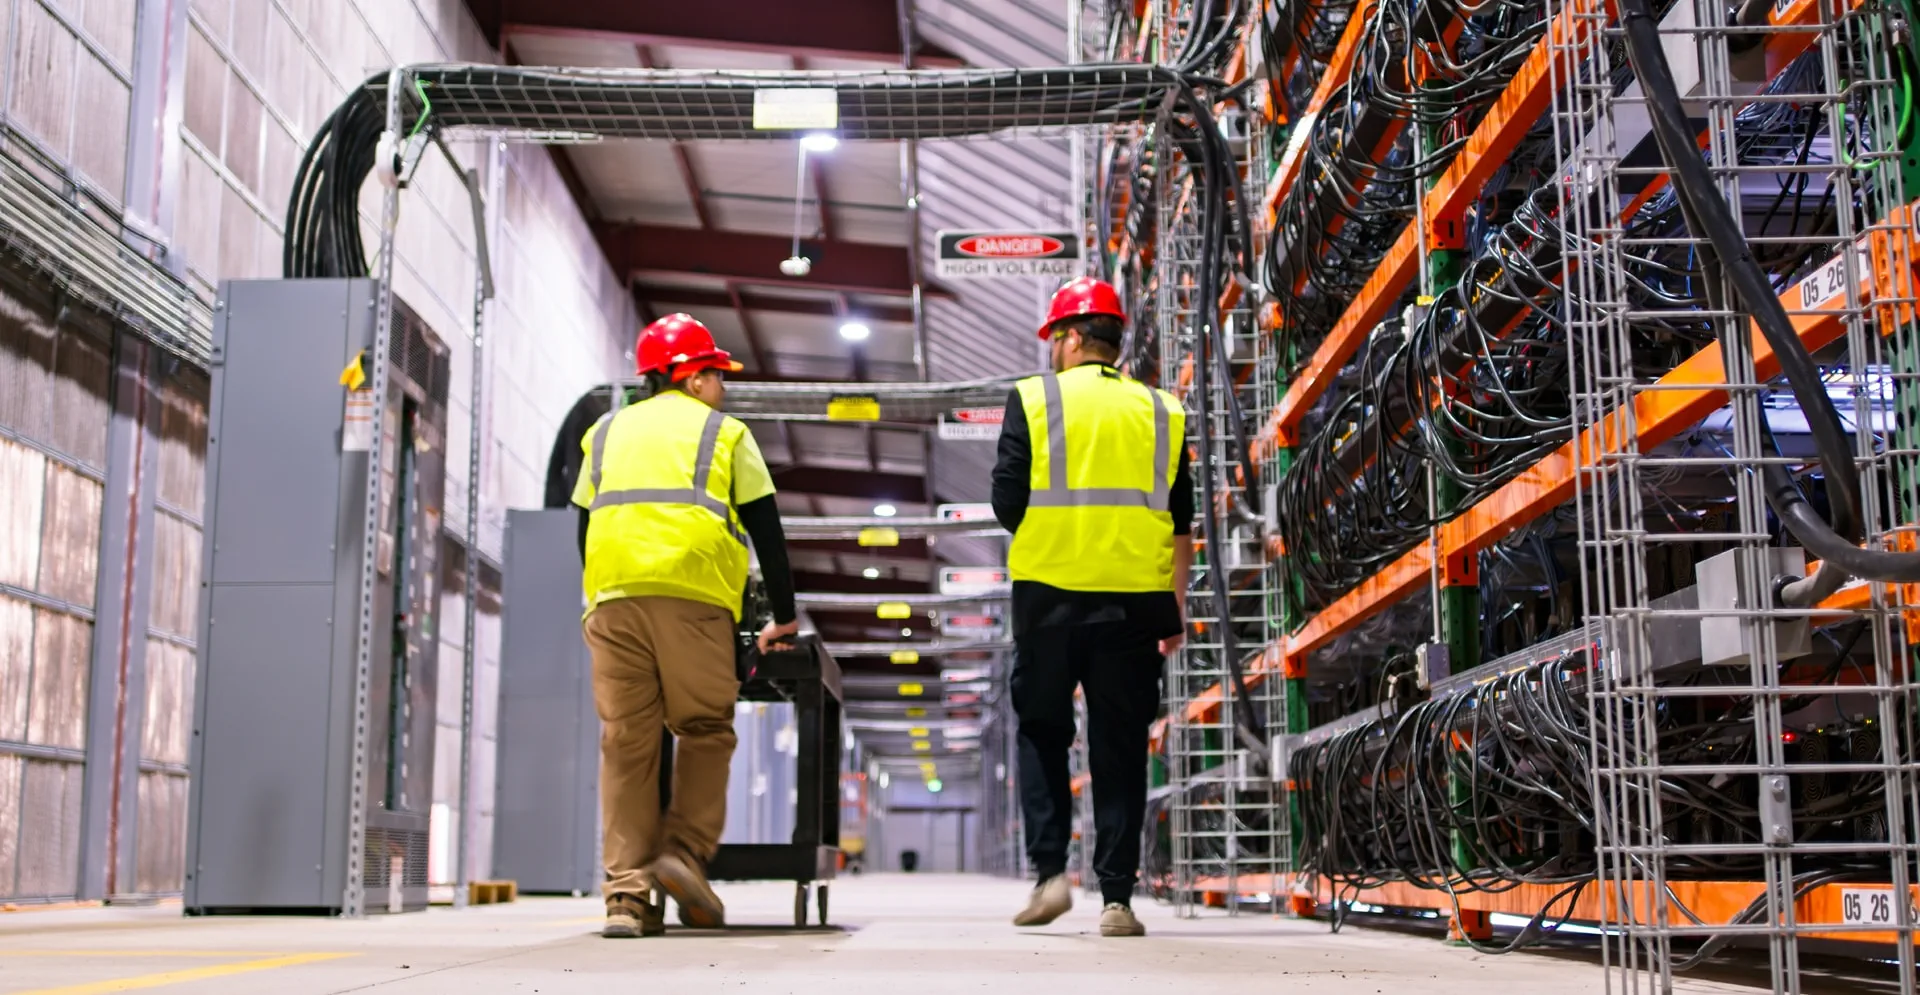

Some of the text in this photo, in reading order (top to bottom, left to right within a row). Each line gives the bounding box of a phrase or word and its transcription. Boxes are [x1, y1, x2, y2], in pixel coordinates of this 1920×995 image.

[975, 238, 1044, 253] DANGER
[945, 261, 1073, 274] HIGH VOLTAGE
